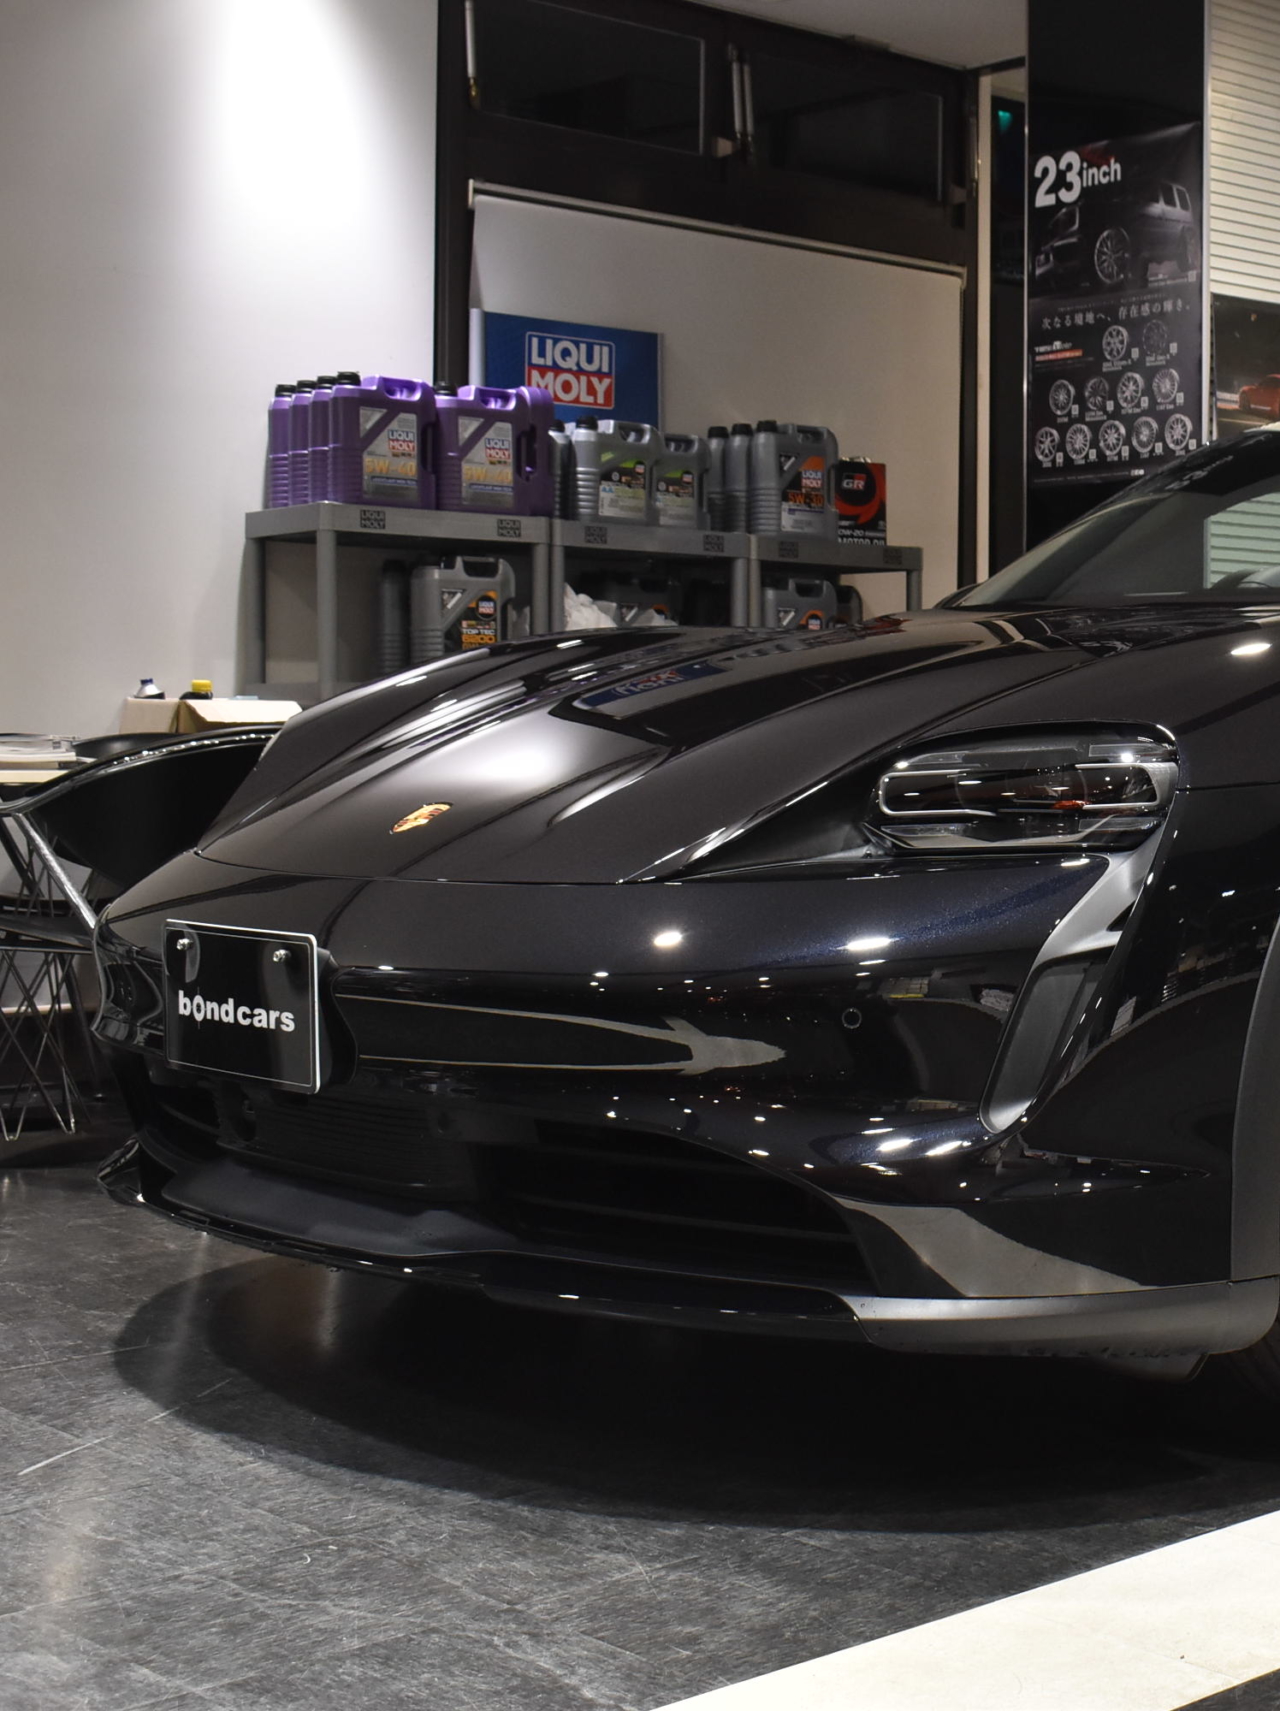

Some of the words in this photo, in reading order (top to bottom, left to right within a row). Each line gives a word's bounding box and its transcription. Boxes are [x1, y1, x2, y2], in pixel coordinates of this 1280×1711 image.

[531, 336, 610, 373] LIQUI
[531, 369, 612, 404] MOLY
[389, 430, 415, 441] LIQUI
[389, 440, 416, 451] MOLY
[485, 439, 511, 449] LIQUI
[486, 448, 511, 459] MOLY
[802, 470, 822, 479] LIQUI
[842, 478, 865, 489] GR
[362, 510, 385, 520] LIQUI
[361, 519, 385, 529] MOLY
